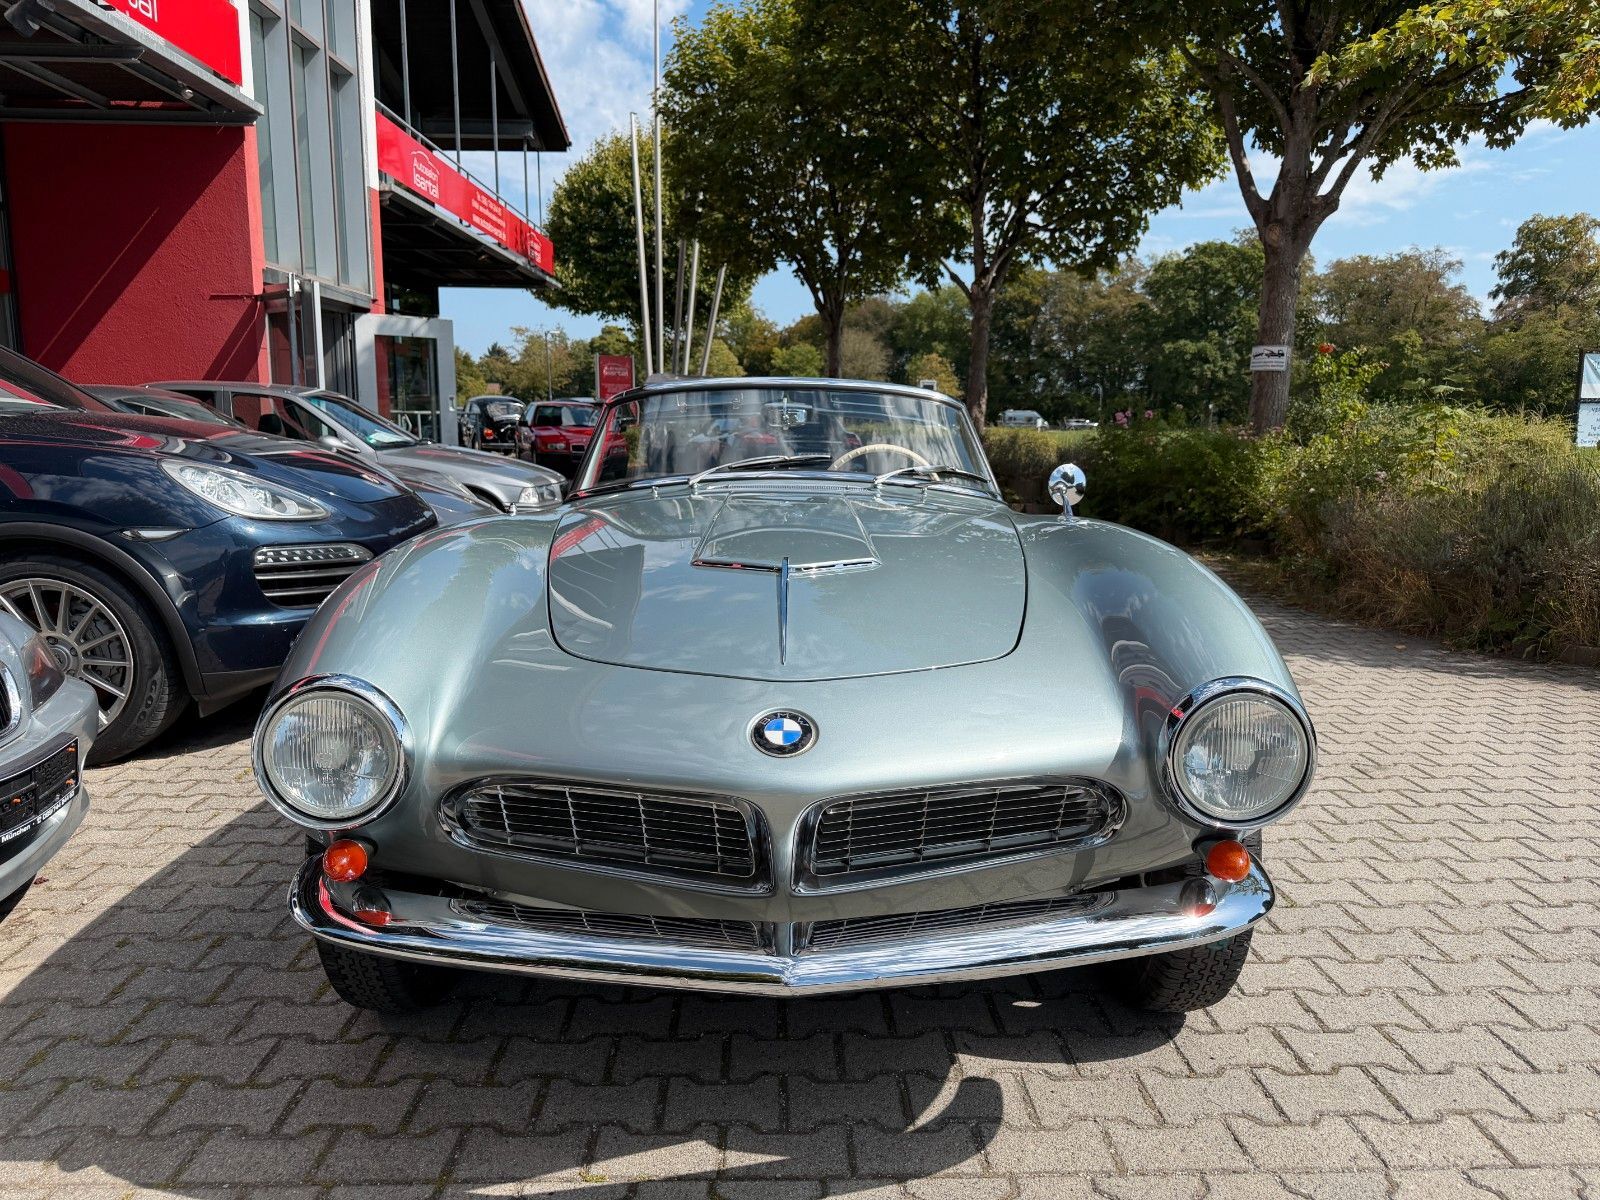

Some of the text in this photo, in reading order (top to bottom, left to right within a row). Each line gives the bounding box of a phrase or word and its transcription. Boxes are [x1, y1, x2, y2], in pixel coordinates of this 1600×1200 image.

[413, 157, 439, 182] Autosalon
[413, 166, 440, 199] Isartal
[760, 712, 809, 726] BMW
[1, 824, 31, 843] München
